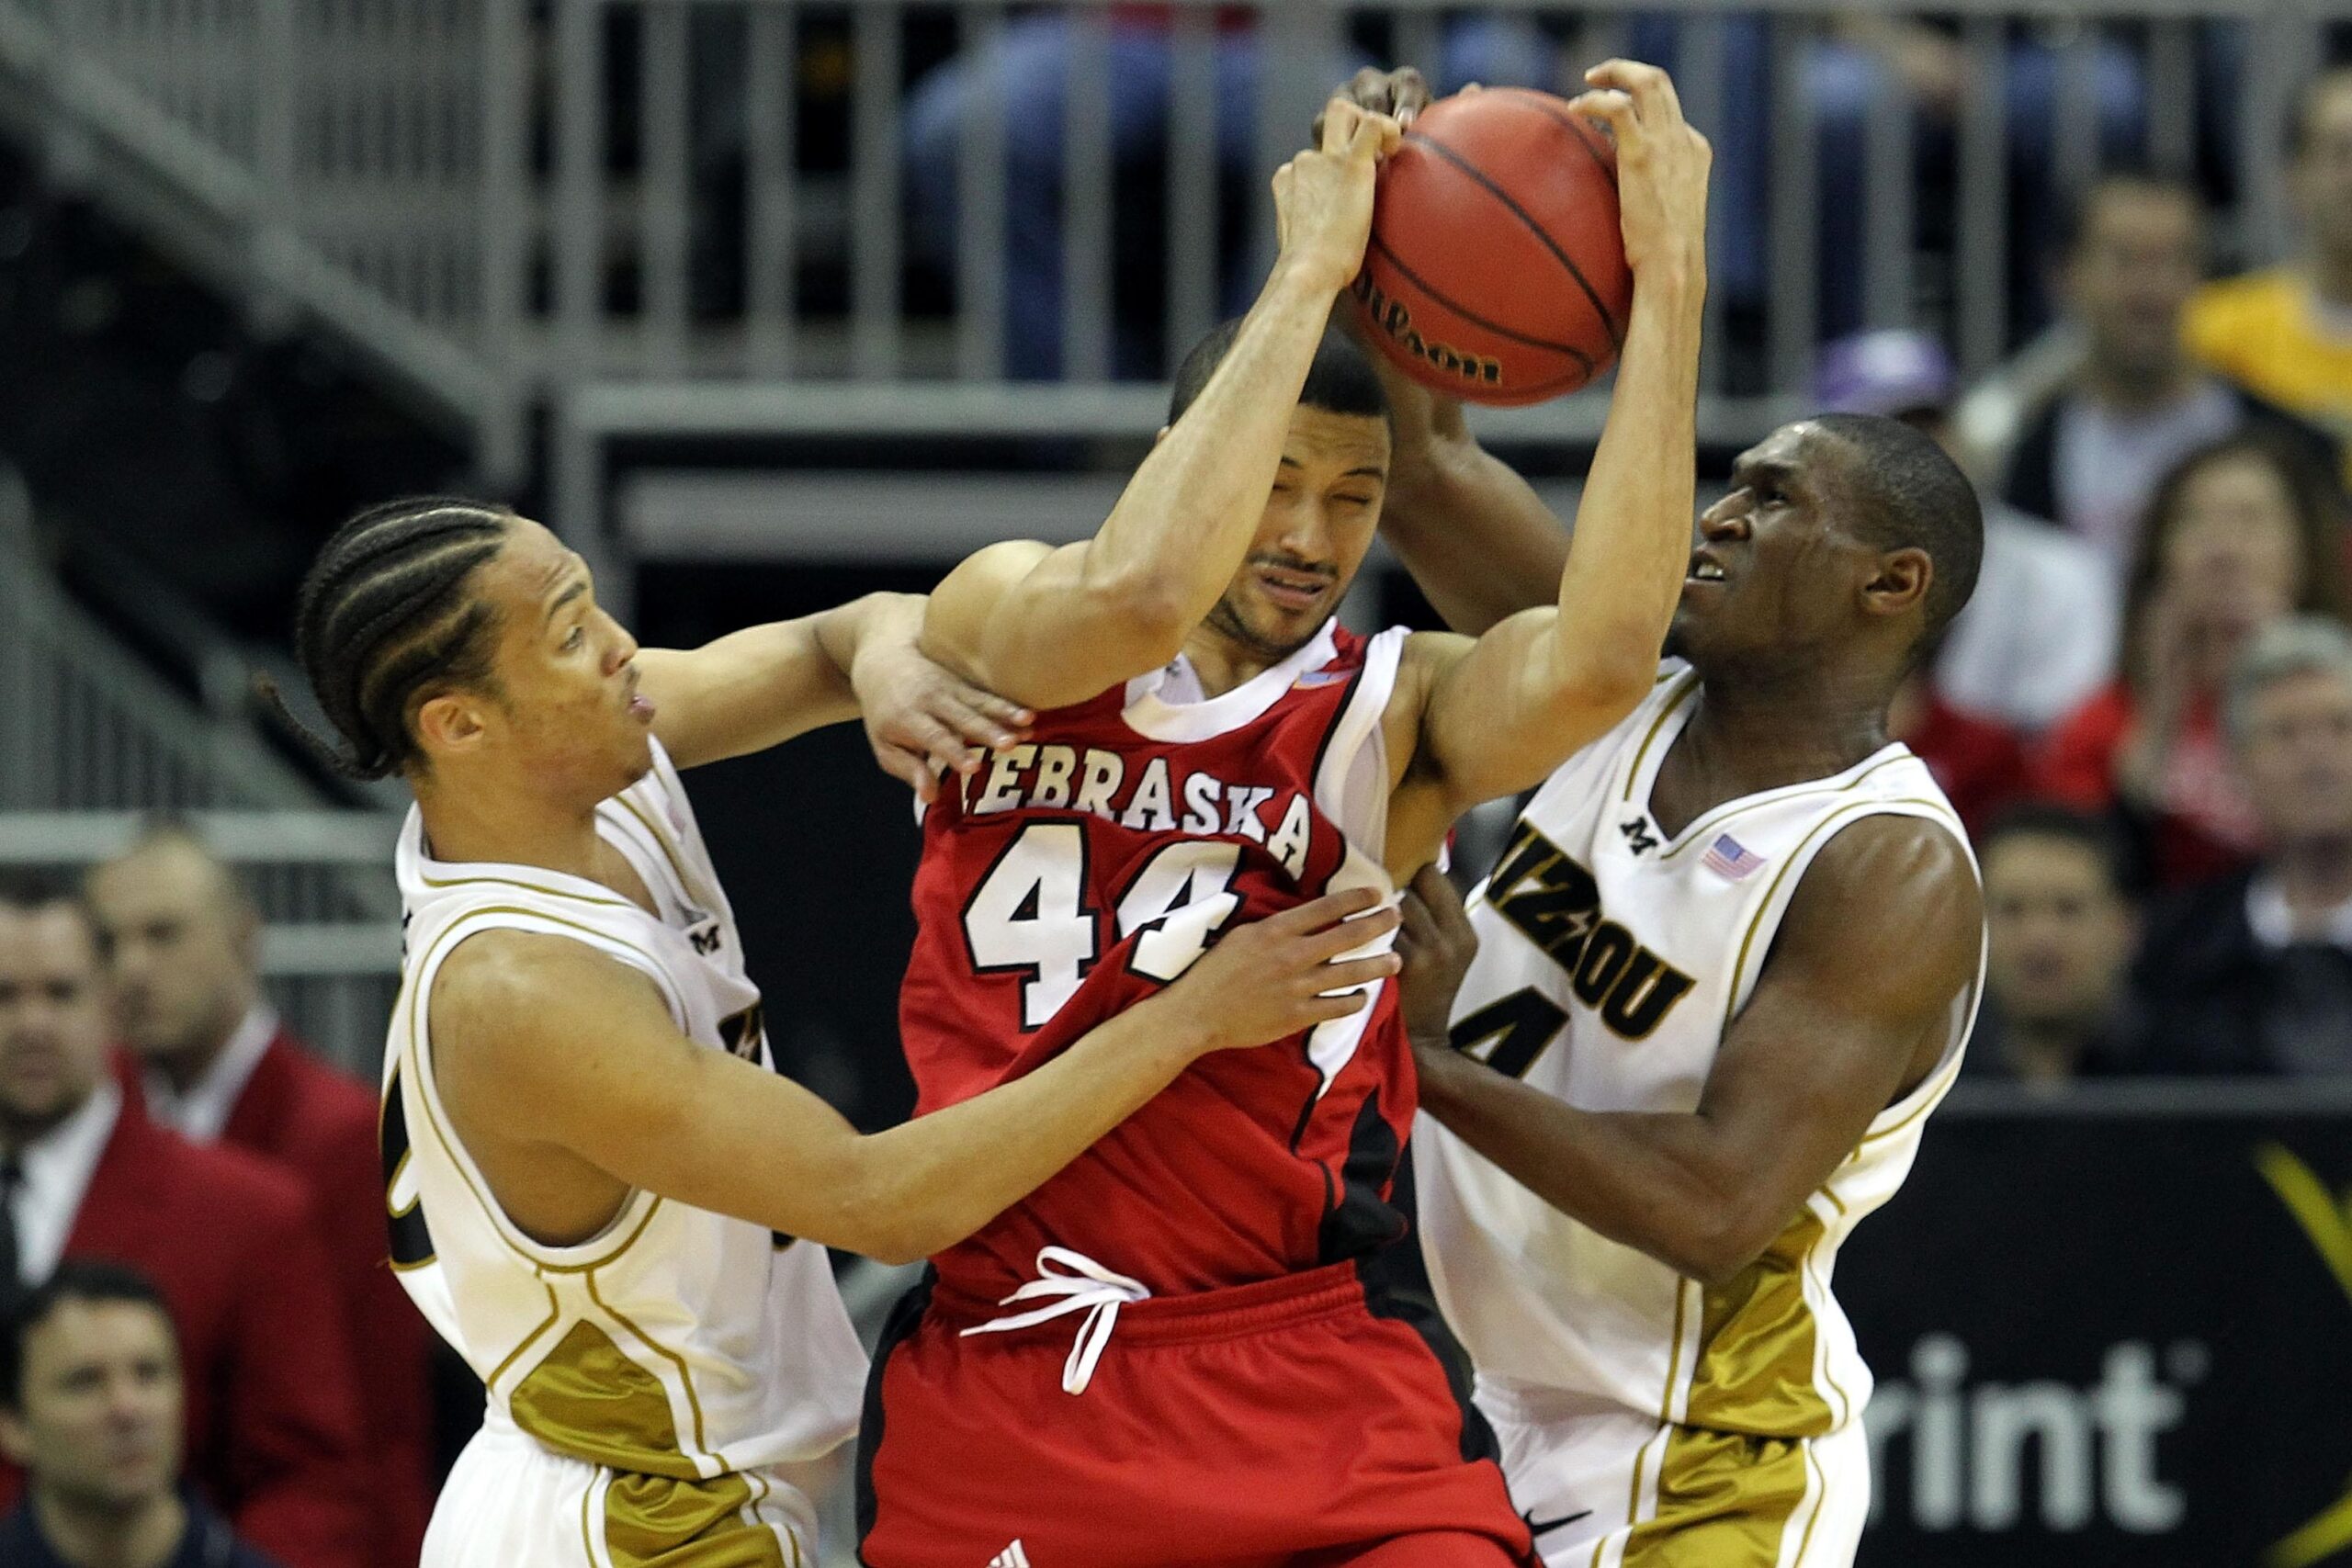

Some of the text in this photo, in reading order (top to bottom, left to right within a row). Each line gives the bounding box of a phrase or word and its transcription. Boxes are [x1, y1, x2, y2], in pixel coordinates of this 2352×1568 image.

[1483, 817, 1697, 1043] IZZOU
[1620, 817, 1657, 856] M
[1865, 1331, 2187, 1533] rint
